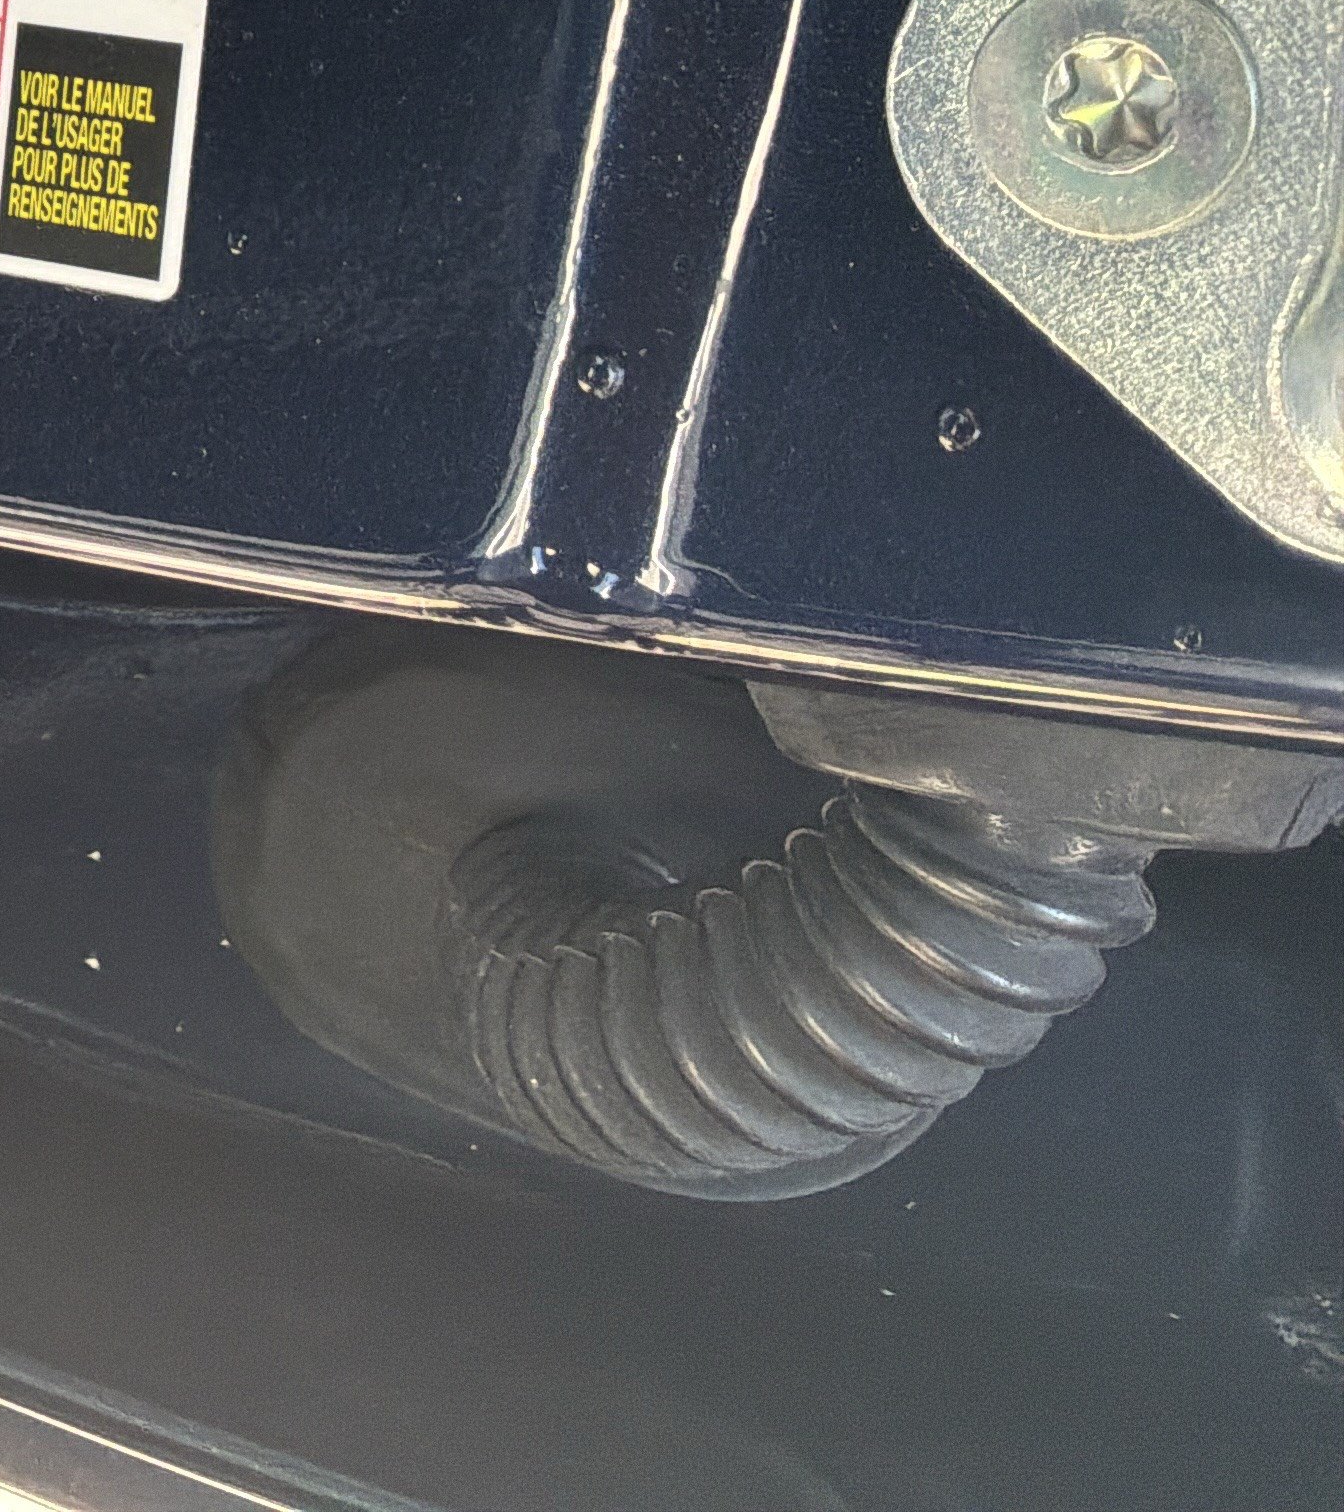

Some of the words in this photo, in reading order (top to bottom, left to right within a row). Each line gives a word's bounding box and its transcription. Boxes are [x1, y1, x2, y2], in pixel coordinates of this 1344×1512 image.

[20, 70, 60, 109] VOIR
[61, 76, 84, 112] LE
[84, 79, 156, 123] MANUEL
[15, 107, 40, 144] DE
[41, 111, 123, 156] L'USAGER
[11, 145, 58, 185] POUR
[60, 152, 104, 192] PLUS
[105, 159, 131, 197] DE
[8, 190, 159, 240] RENSEIGNEMENTS
